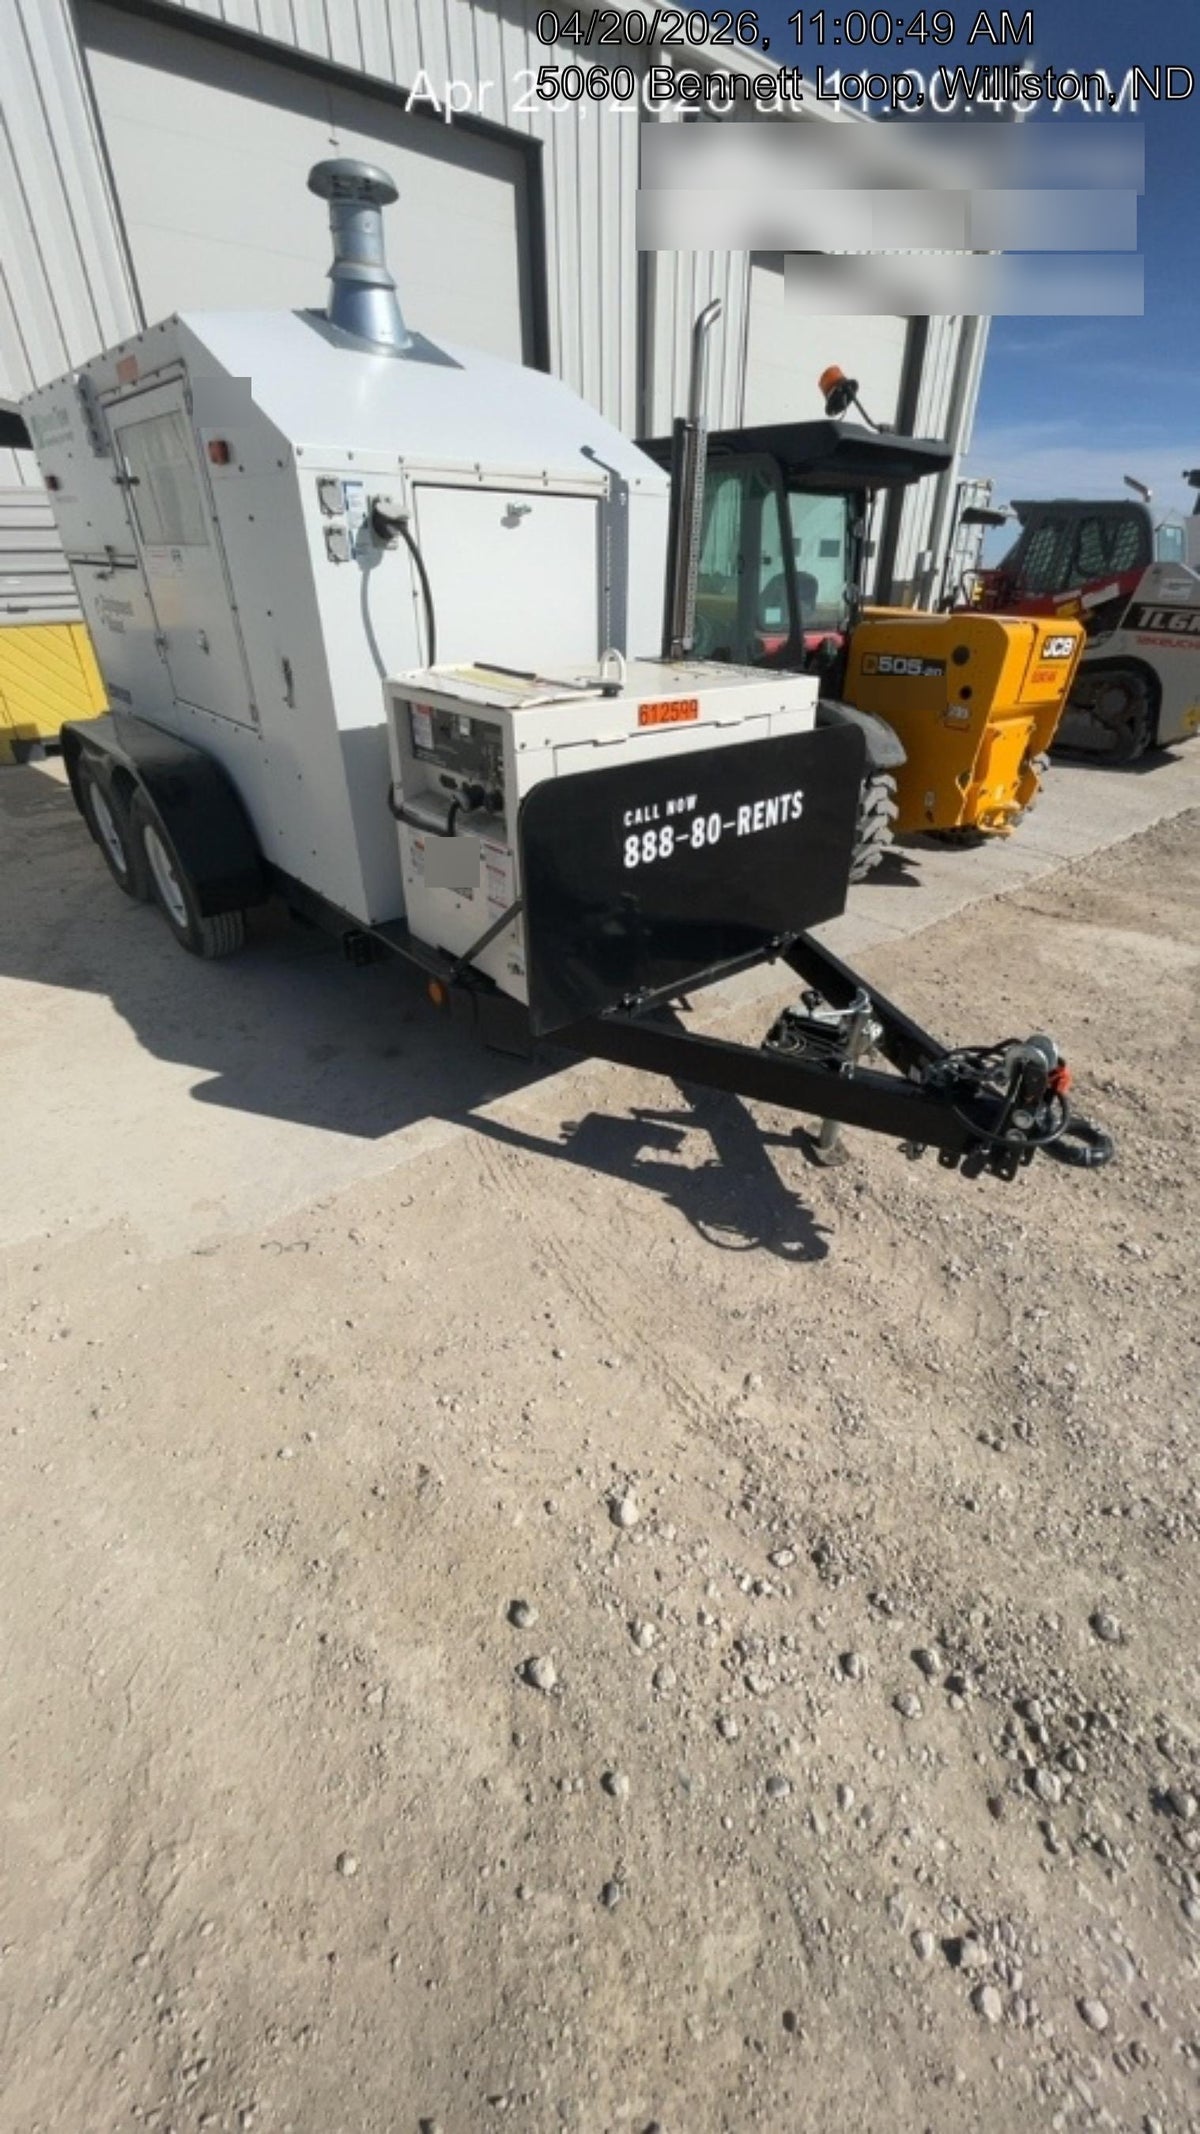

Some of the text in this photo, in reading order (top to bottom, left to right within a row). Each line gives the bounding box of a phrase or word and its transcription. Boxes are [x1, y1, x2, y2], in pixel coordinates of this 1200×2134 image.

[623, 794, 698, 827] CALL NOW
[623, 789, 804, 868] 888-80-RENTS
